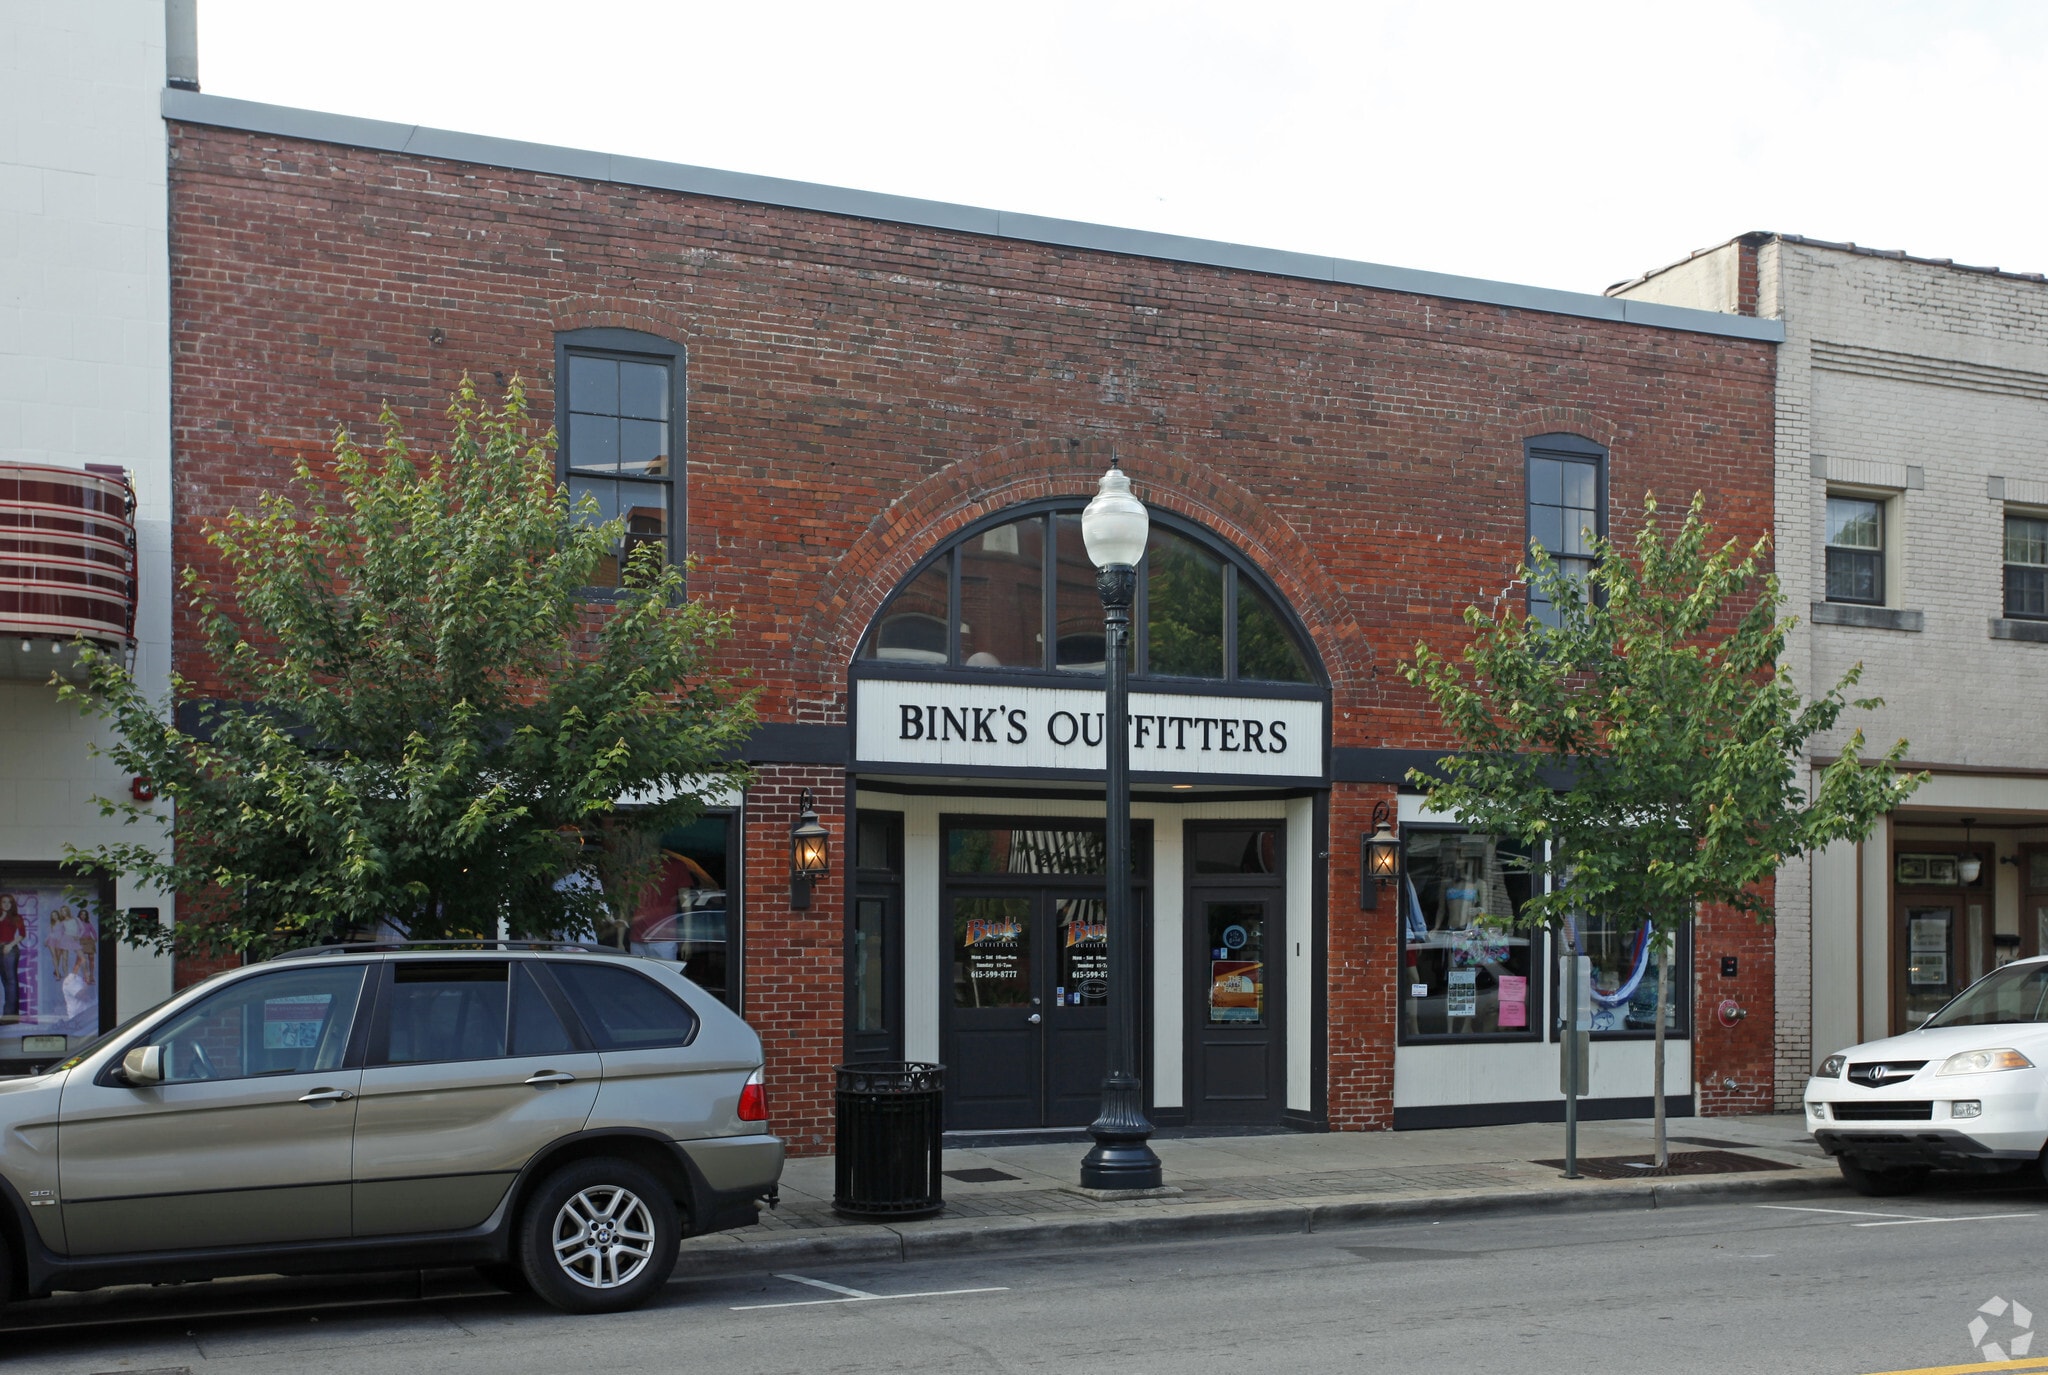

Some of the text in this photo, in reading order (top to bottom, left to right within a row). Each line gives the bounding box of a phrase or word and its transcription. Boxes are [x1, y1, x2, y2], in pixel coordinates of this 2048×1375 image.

[899, 704, 1287, 753] BINK'S OUFITTERS
[964, 916, 1022, 947] Bink's
[1066, 917, 1107, 947] Bin
[1072, 971, 1108, 979] 615-599-87
